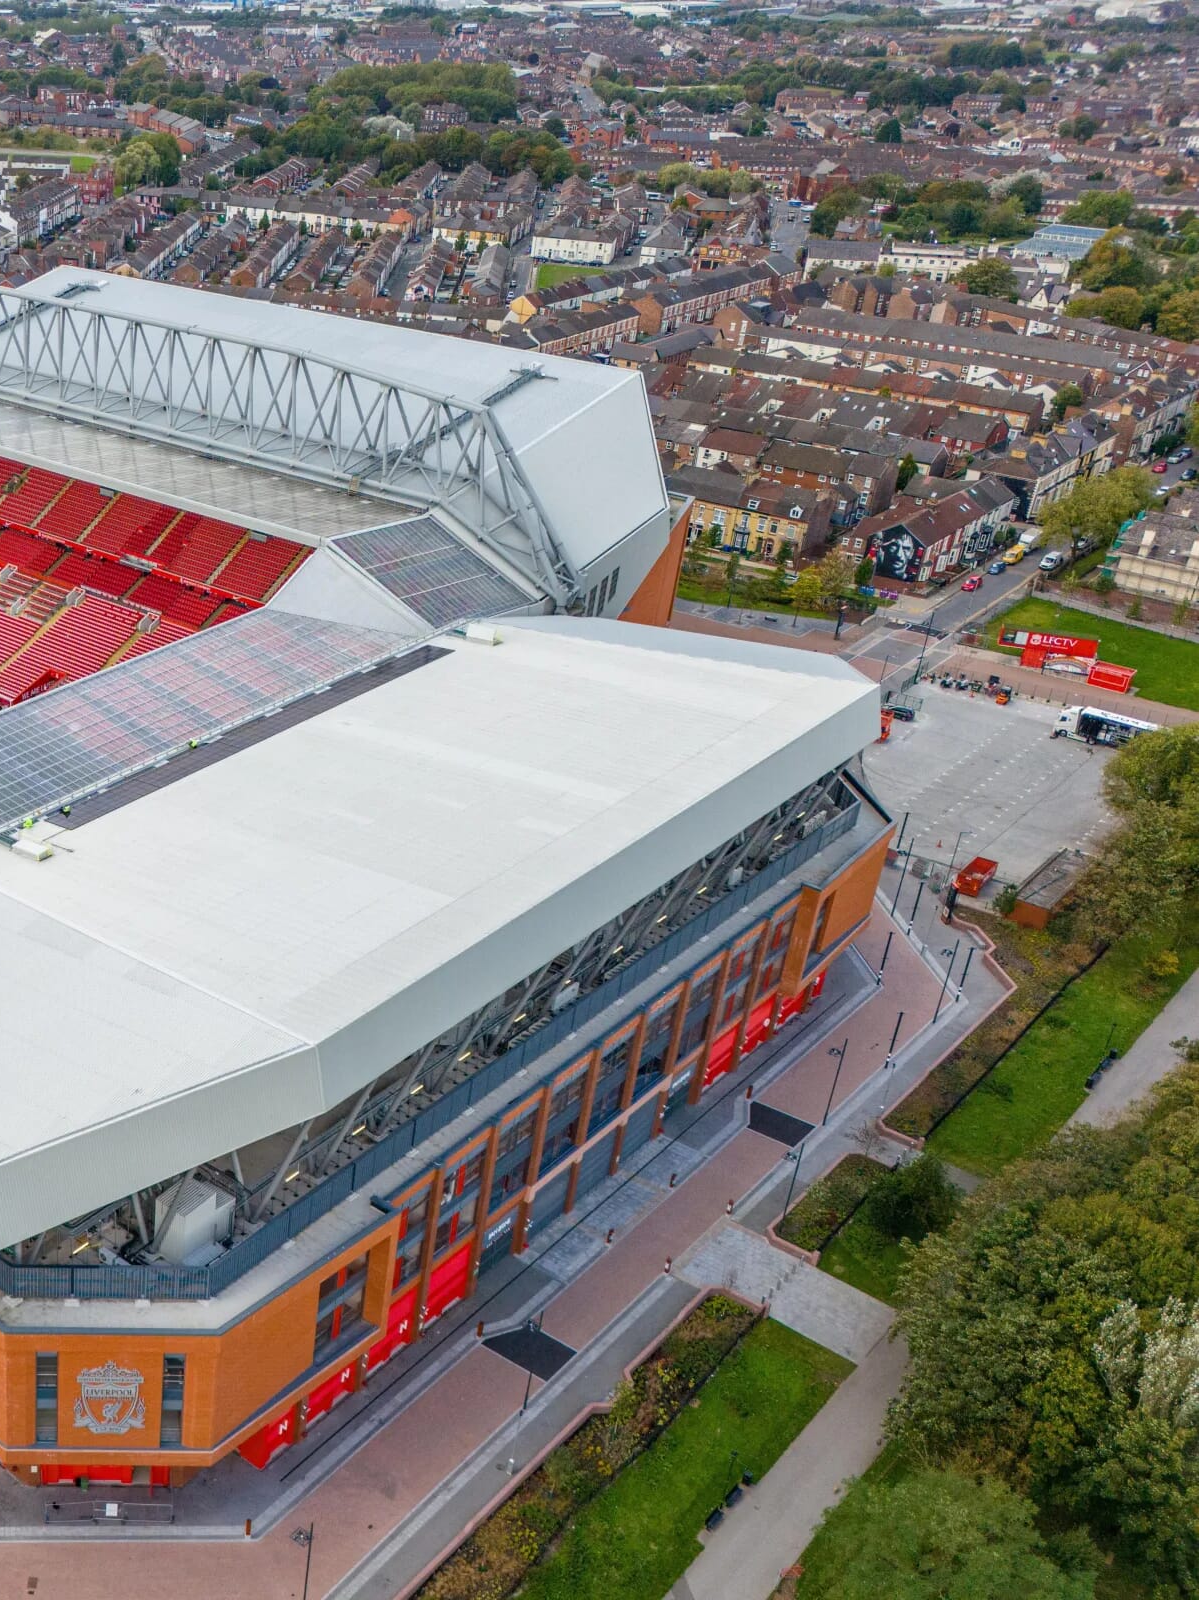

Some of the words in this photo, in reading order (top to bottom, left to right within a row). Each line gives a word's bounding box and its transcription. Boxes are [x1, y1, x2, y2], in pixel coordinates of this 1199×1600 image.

[398, 1319, 408, 1334] N
[340, 1367, 351, 1383] N
[86, 1388, 132, 1396] LIVERPOOL
[278, 1419, 289, 1435] N
